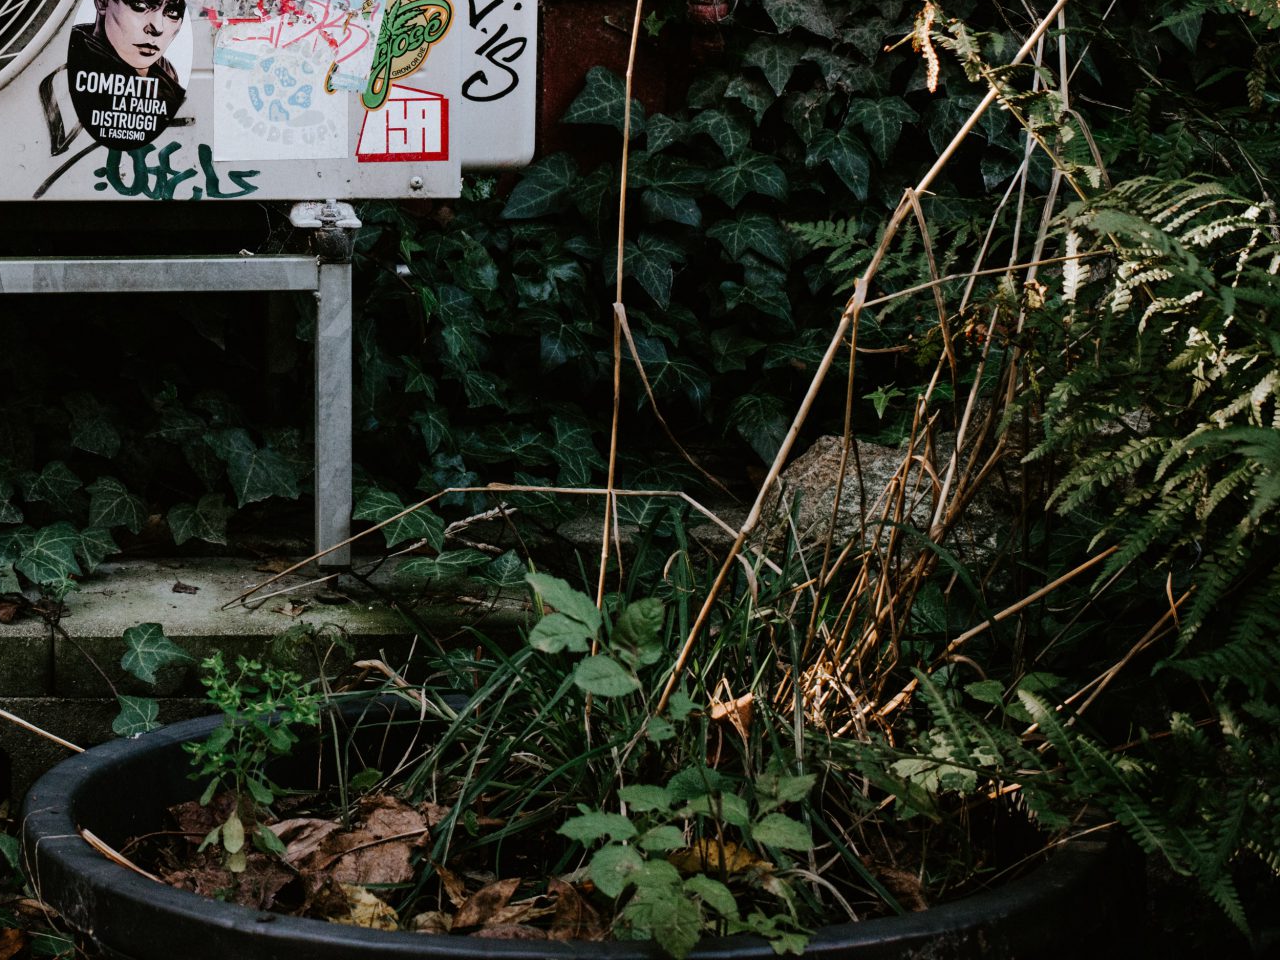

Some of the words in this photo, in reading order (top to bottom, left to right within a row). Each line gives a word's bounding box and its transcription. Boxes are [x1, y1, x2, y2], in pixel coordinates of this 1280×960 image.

[392, 63, 412, 77] GROW
[410, 57, 420, 68] OR
[418, 47, 426, 61] DIE
[75, 70, 159, 99] COMBATTI
[112, 95, 127, 112] LA
[129, 97, 168, 115] PAURA
[91, 109, 158, 131] DISTRUGGI
[99, 127, 107, 138] IL
[108, 128, 146, 141] FASCISMO
